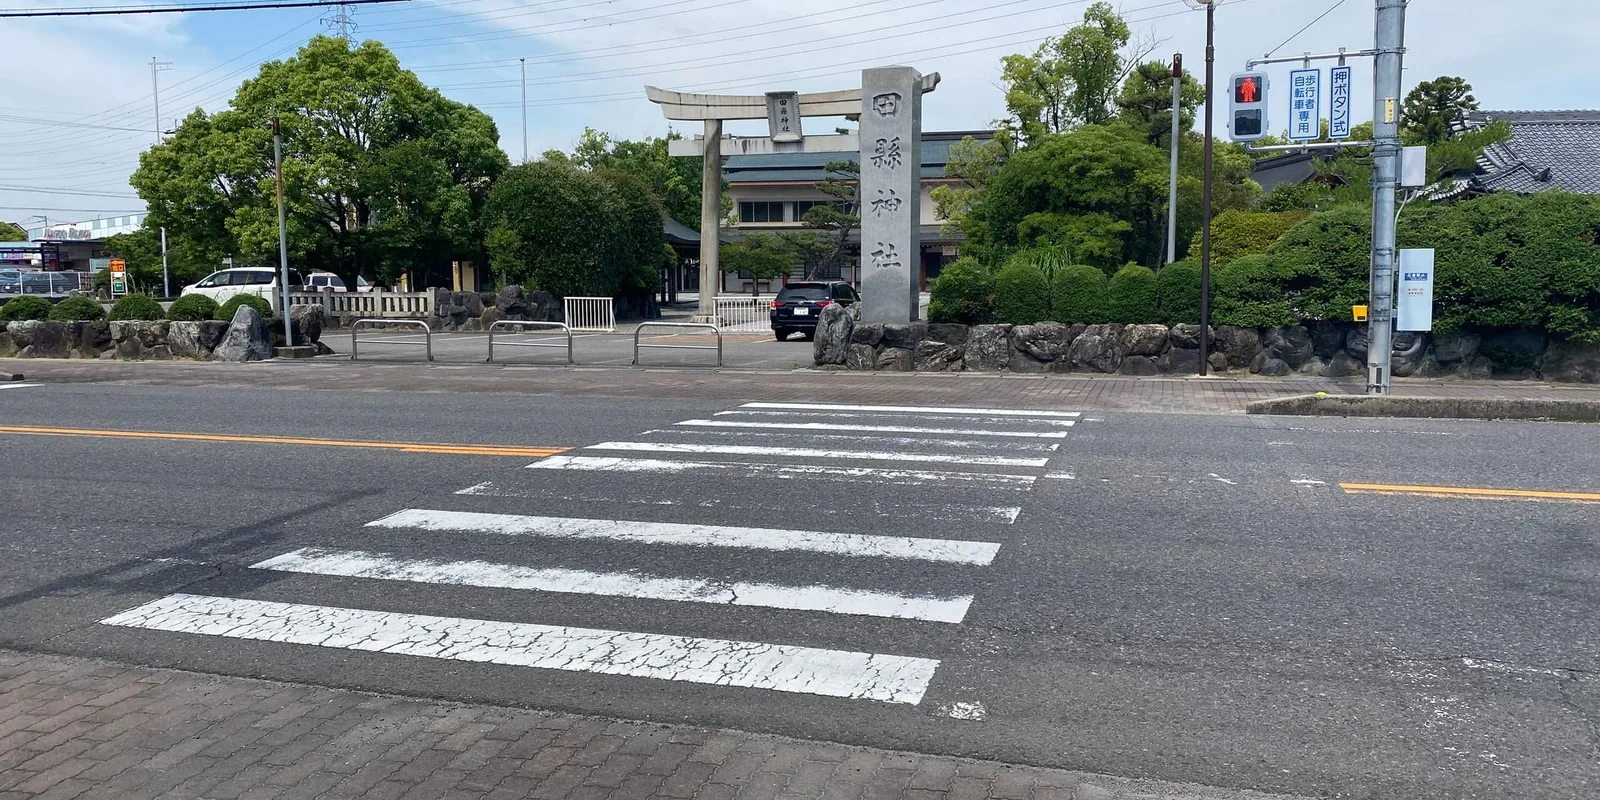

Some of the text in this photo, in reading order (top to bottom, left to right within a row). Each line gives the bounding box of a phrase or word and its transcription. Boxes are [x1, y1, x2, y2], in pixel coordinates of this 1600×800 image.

[1294, 76, 1305, 110] 自転車
[1305, 75, 1317, 109] 歩行者
[1334, 71, 1348, 133] 押ボタン式
[1298, 111, 1310, 133] 専用
[870, 92, 902, 268] 田縣神社
